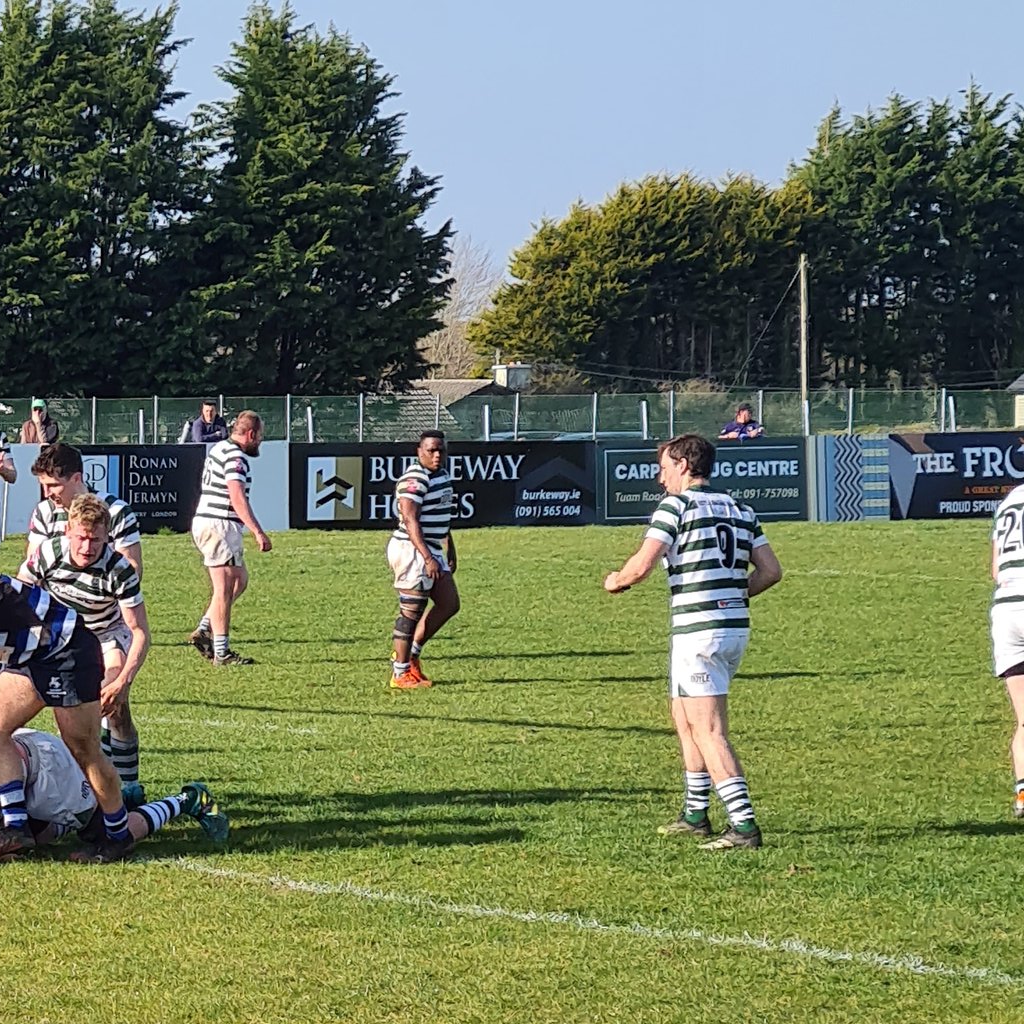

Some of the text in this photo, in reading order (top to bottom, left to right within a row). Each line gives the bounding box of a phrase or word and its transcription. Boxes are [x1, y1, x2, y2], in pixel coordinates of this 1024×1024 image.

[129, 455, 178, 469] RONAN
[369, 454, 525, 483] BUEWAY
[912, 453, 956, 474] THE
[615, 460, 799, 481] CARP UG CENTRE
[129, 472, 164, 486] DALY
[128, 489, 178, 506] JERMYN
[522, 489, 581, 502] burkeway.ie
[614, 491, 641, 502] Tuam
[368, 492, 475, 520] HES
[515, 505, 581, 518] (091) 565 004
[939, 501, 971, 513] PROUD
